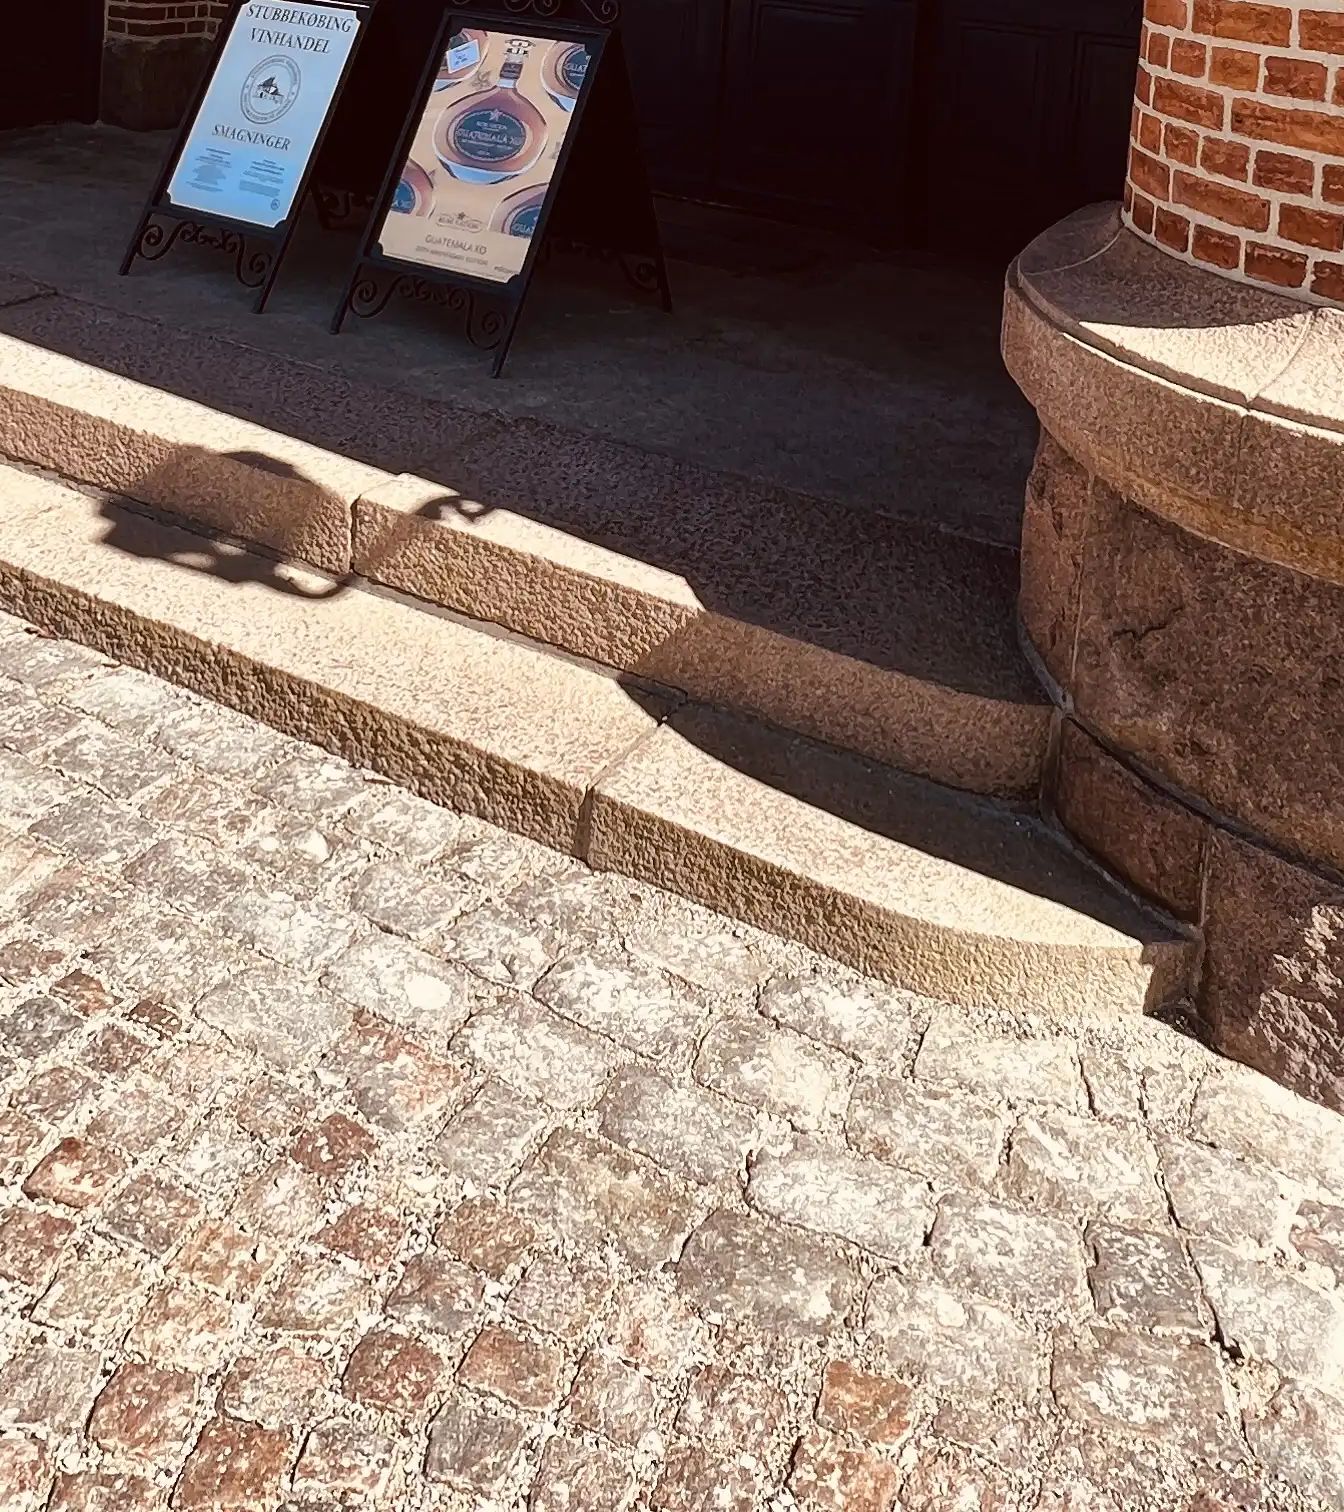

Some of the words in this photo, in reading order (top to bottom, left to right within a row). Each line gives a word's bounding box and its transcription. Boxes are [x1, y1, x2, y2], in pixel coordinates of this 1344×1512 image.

[246, 3, 353, 33] STUBBEKØBING
[251, 27, 331, 54] VINHANDEL
[212, 124, 291, 151] SMAGNINGER
[425, 234, 473, 251] GUATEMALA
[474, 245, 487, 255] XO
